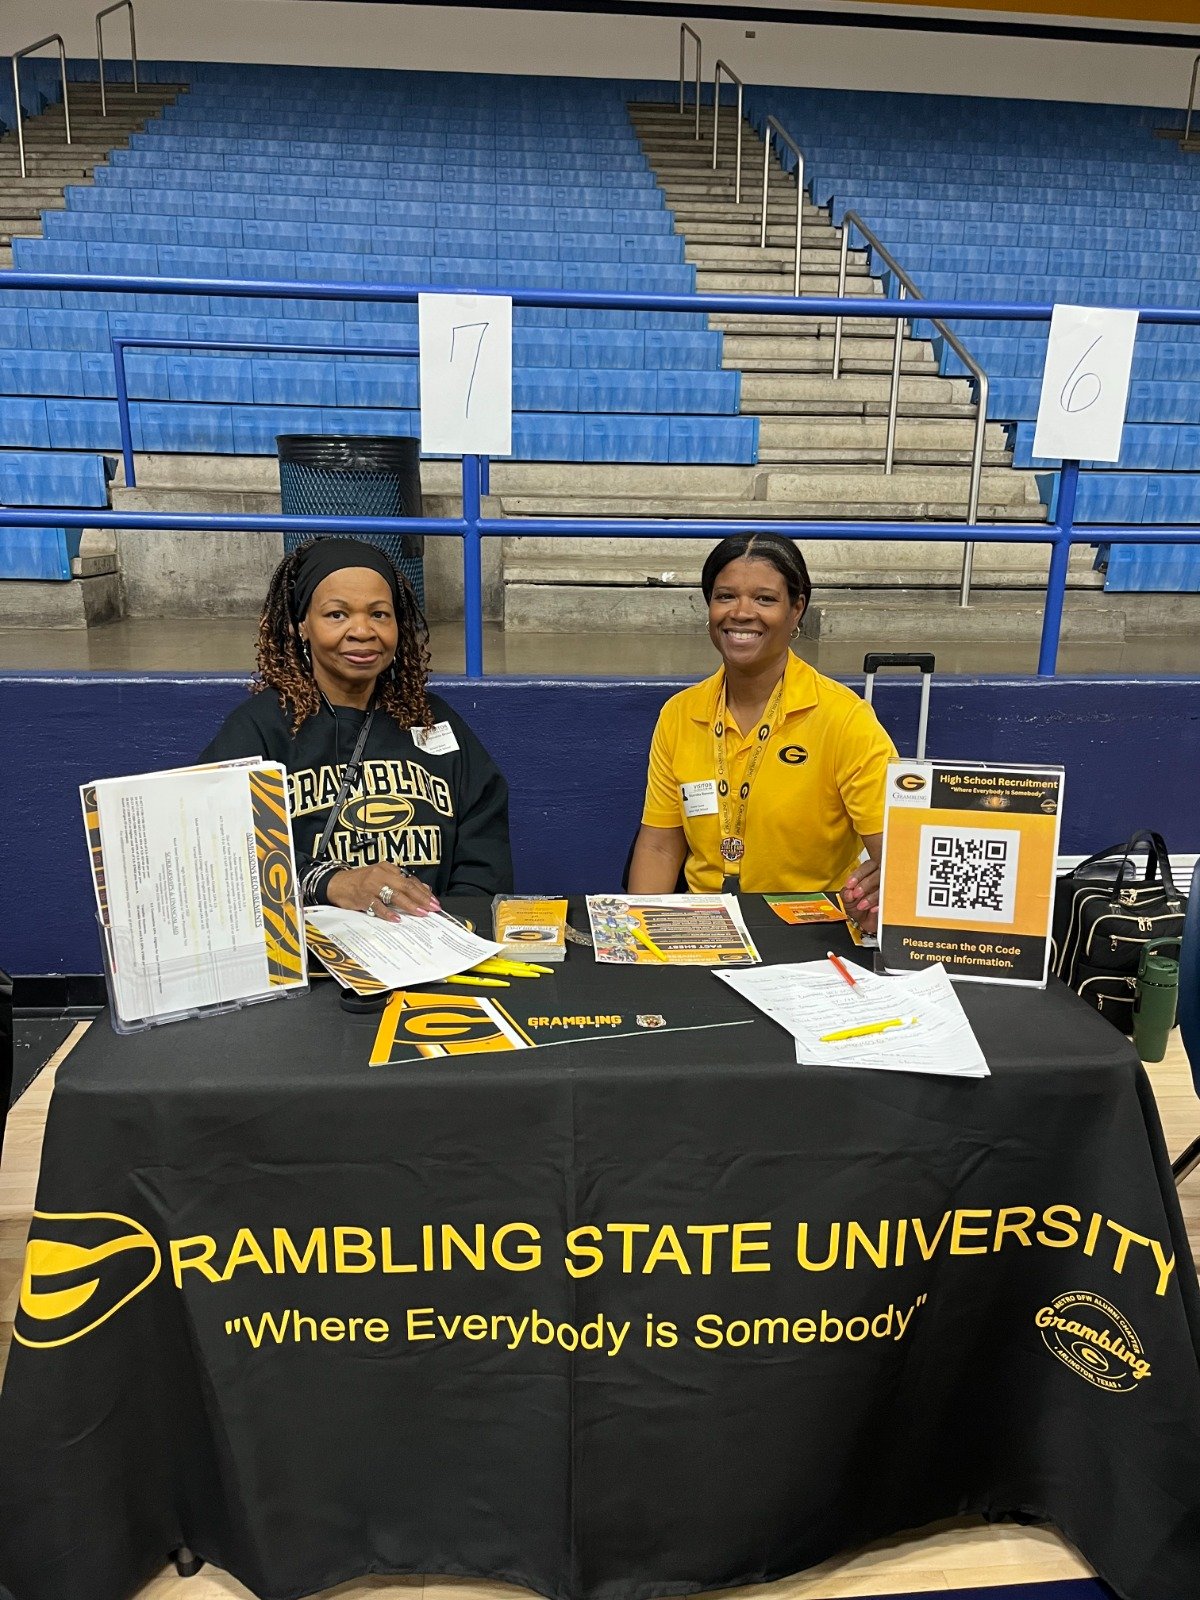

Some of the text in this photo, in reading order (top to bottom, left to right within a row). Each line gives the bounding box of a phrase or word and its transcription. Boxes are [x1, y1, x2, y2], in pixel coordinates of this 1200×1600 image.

[449, 321, 489, 420] 7
[1059, 334, 1103, 414] 6
[939, 774, 1059, 790] High School Recruitment
[972, 787, 1005, 797] Everybody
[246, 832, 263, 928] ADMISSIONS REQUIREMENTS
[902, 937, 1021, 956] Please scan the QR Code
[909, 950, 1014, 968] for more information.
[527, 1014, 622, 1027] GRAMBLING
[564, 1221, 772, 1279] STATE
[796, 1204, 1176, 1297] UNIVERSITY
[406, 1307, 631, 1357] Everybody
[645, 1313, 679, 1348] is
[1034, 1306, 1152, 1380] Grambling
[1053, 1294, 1141, 1355] METRO DFW ALUMNI CHAPTER
